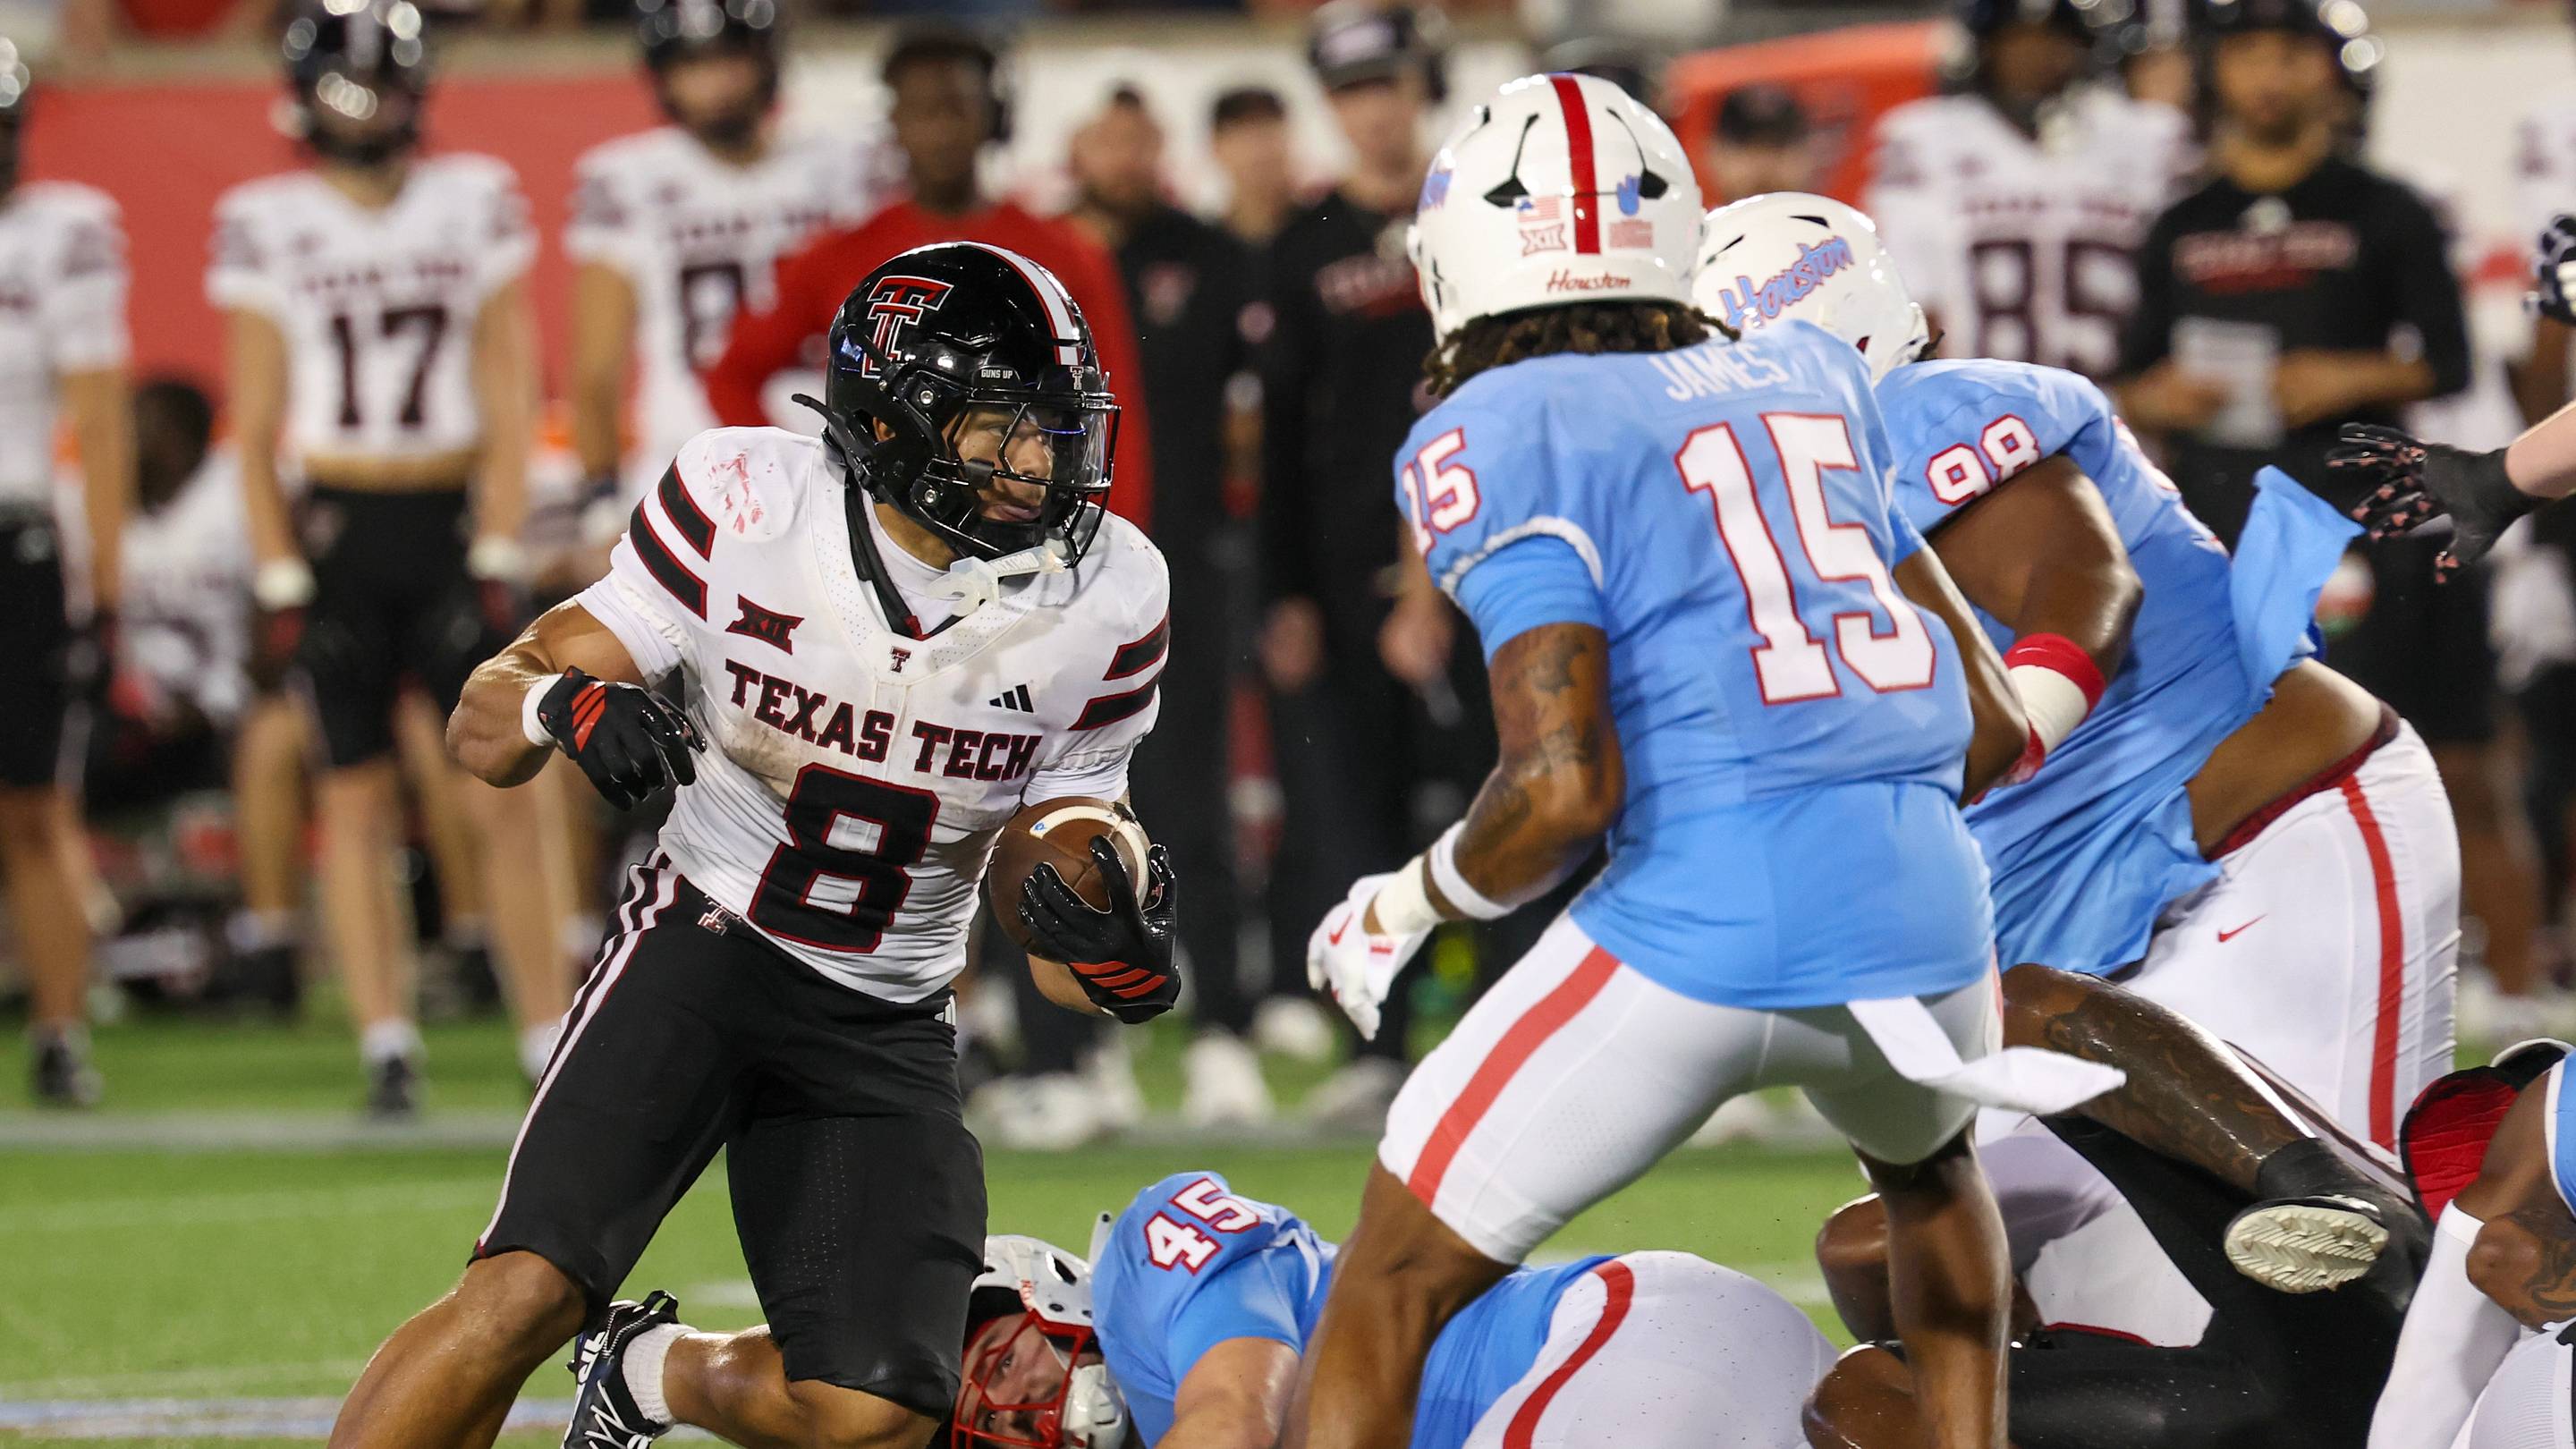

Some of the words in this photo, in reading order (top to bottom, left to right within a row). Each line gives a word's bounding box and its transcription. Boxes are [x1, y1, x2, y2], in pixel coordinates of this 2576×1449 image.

[1546, 269, 1631, 292] Houston
[1718, 234, 1855, 330] Houston
[333, 304, 448, 427] 17
[980, 369, 1001, 378] GUNS
[1003, 369, 1013, 379] UP
[1648, 342, 1790, 402] JAMES
[1402, 425, 1483, 562] 15
[1925, 413, 2040, 505] 98
[1674, 411, 1936, 707] 15
[725, 658, 894, 763] TEXAS
[911, 720, 1042, 782] TECH
[747, 762, 941, 953] 8
[1143, 1176, 1261, 1276] 45
